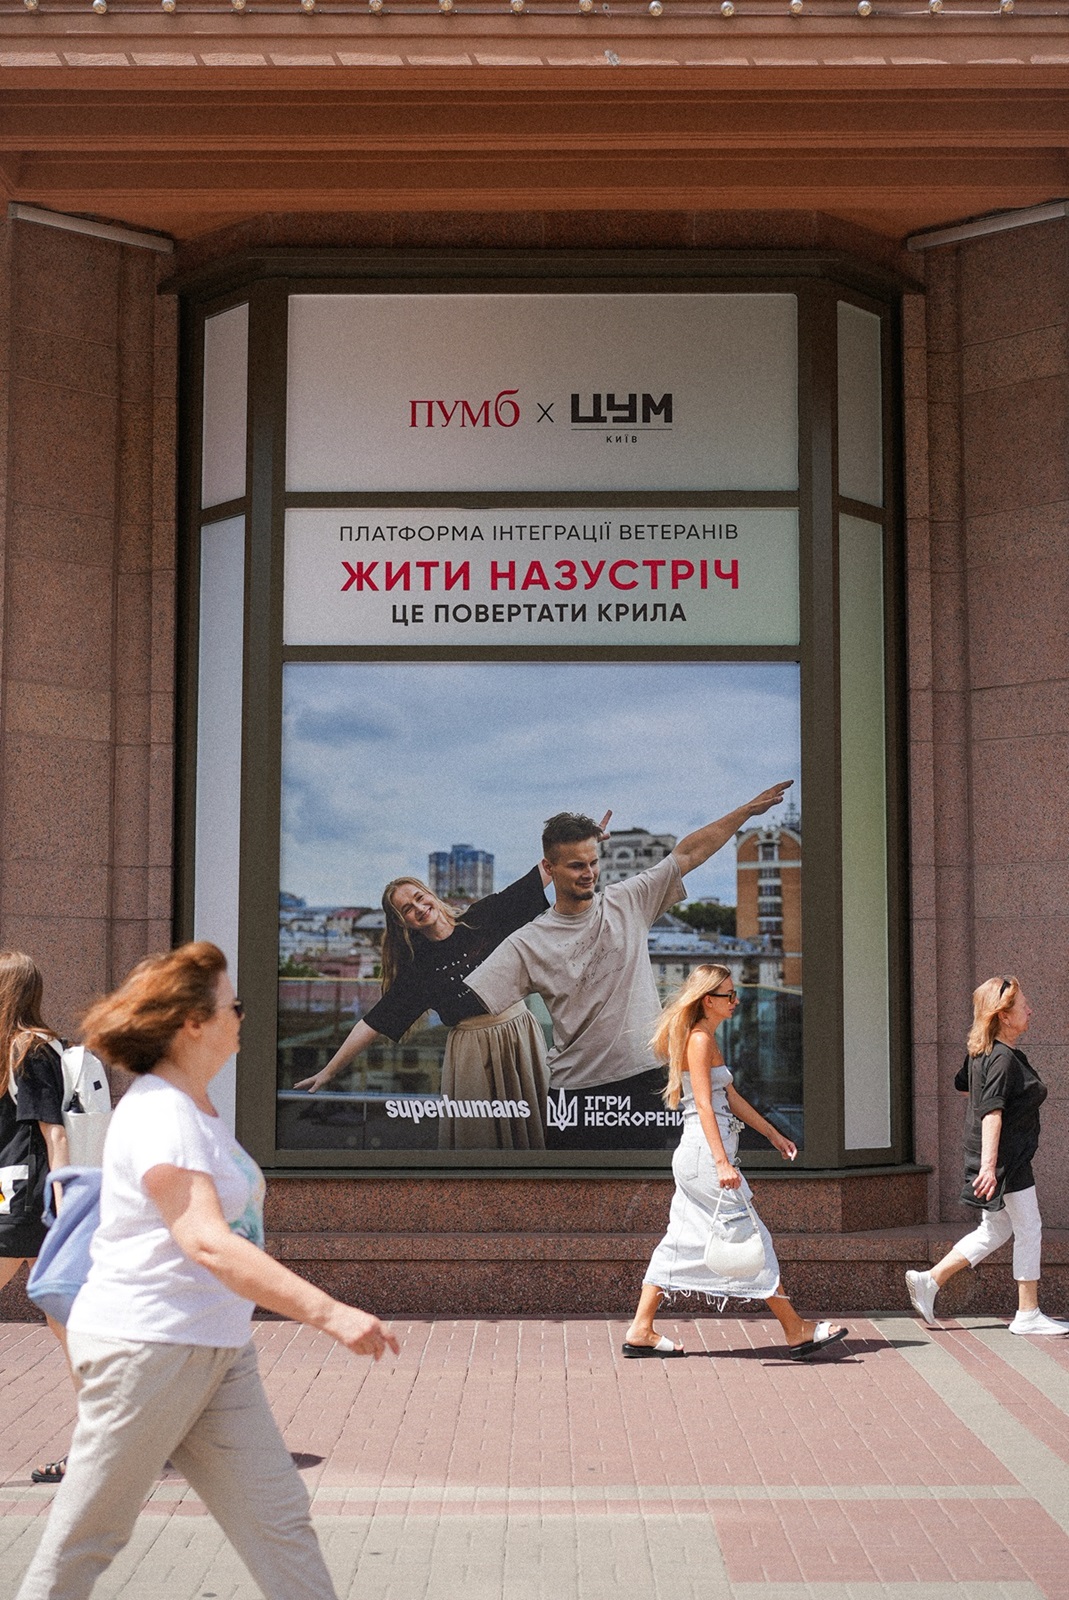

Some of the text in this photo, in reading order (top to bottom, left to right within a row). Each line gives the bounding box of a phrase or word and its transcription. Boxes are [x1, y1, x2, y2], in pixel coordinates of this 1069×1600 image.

[570, 393, 673, 424] ЦУМ
[606, 435, 638, 443] КИЇВ
[340, 522, 739, 542] ПЛАТФОРМА ІНТЕГРАЦІЇ ВЕТЕРАНІВ
[341, 559, 740, 592] ЖИТИ НАЗУСТРІЧ
[392, 603, 687, 625] ЦЕ ПОВЕРТАТИ КРИЛА
[385, 1094, 531, 1123] superhumans
[585, 1095, 631, 1110] ІГРИ
